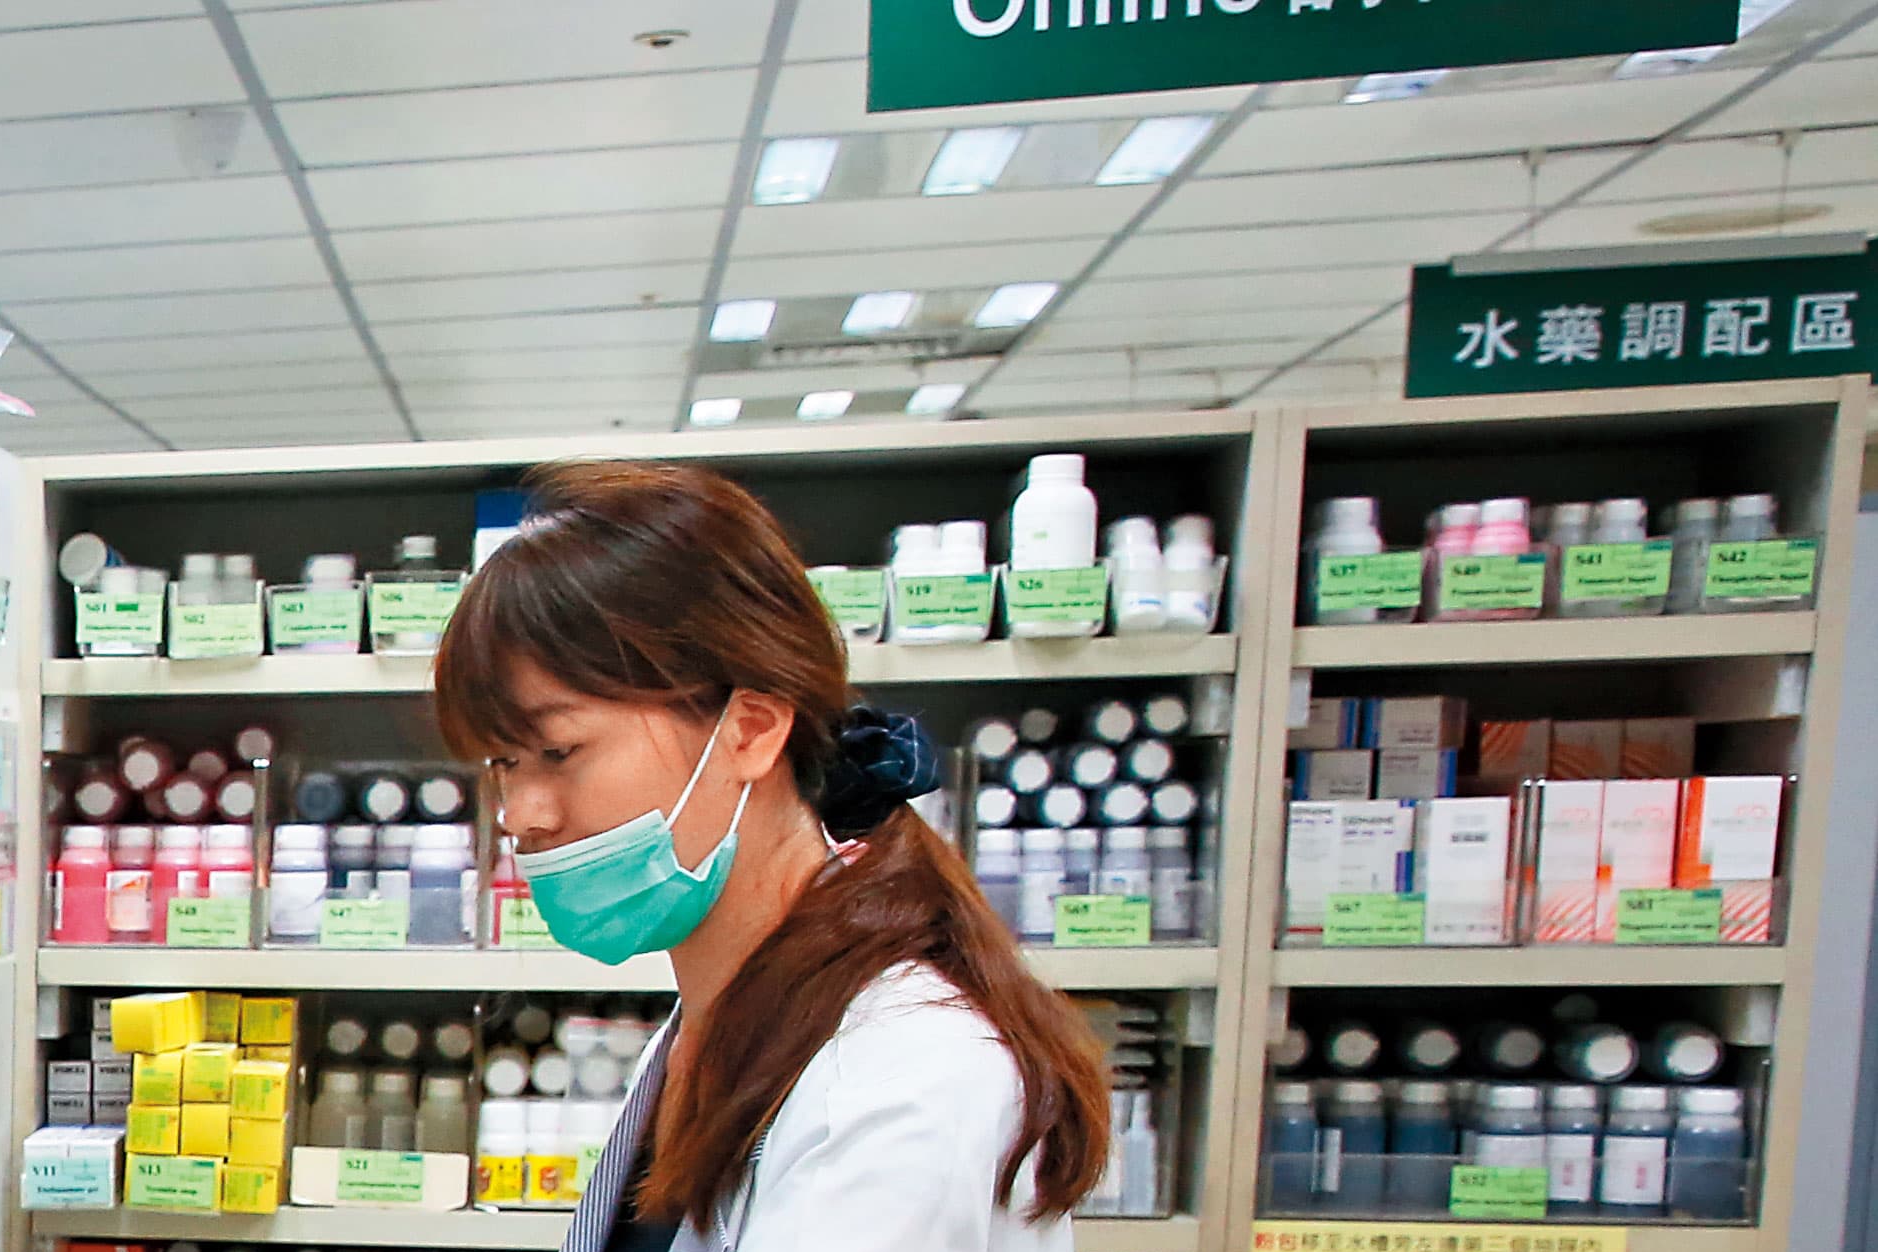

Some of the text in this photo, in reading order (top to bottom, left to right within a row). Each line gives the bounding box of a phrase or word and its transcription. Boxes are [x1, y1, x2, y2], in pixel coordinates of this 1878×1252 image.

[1453, 292, 1859, 369] 水藥調配區
